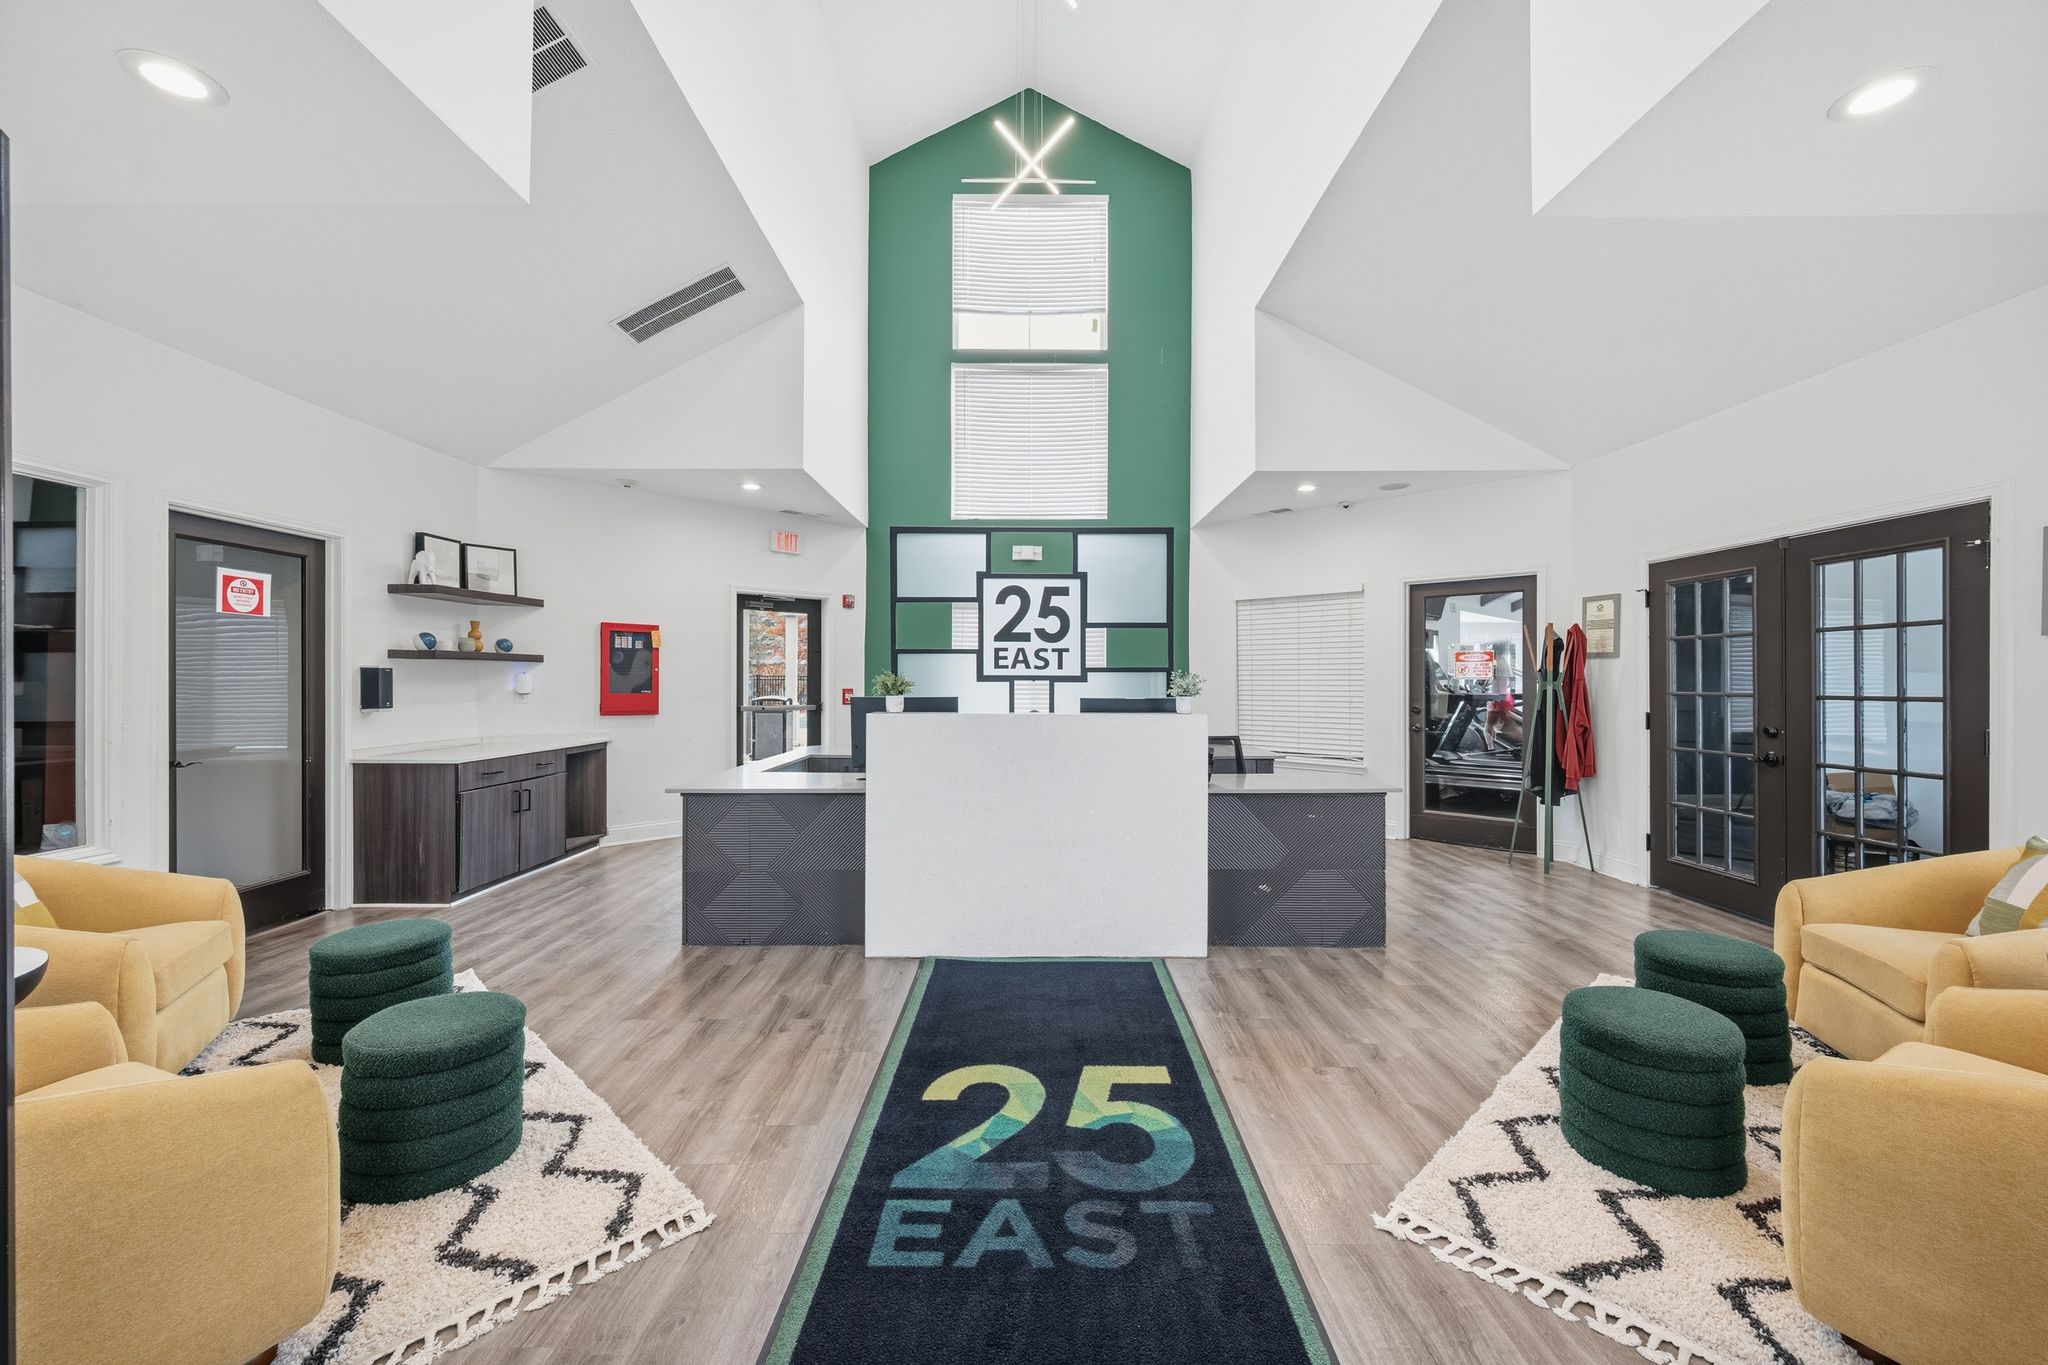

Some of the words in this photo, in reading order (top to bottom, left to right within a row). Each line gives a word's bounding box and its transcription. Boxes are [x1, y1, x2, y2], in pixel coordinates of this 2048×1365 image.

[777, 531, 799, 552] EXIT
[993, 584, 1071, 644] 25
[993, 647, 1070, 670] EAST
[890, 1064, 1196, 1192] 25
[867, 1198, 1215, 1269] EAST
